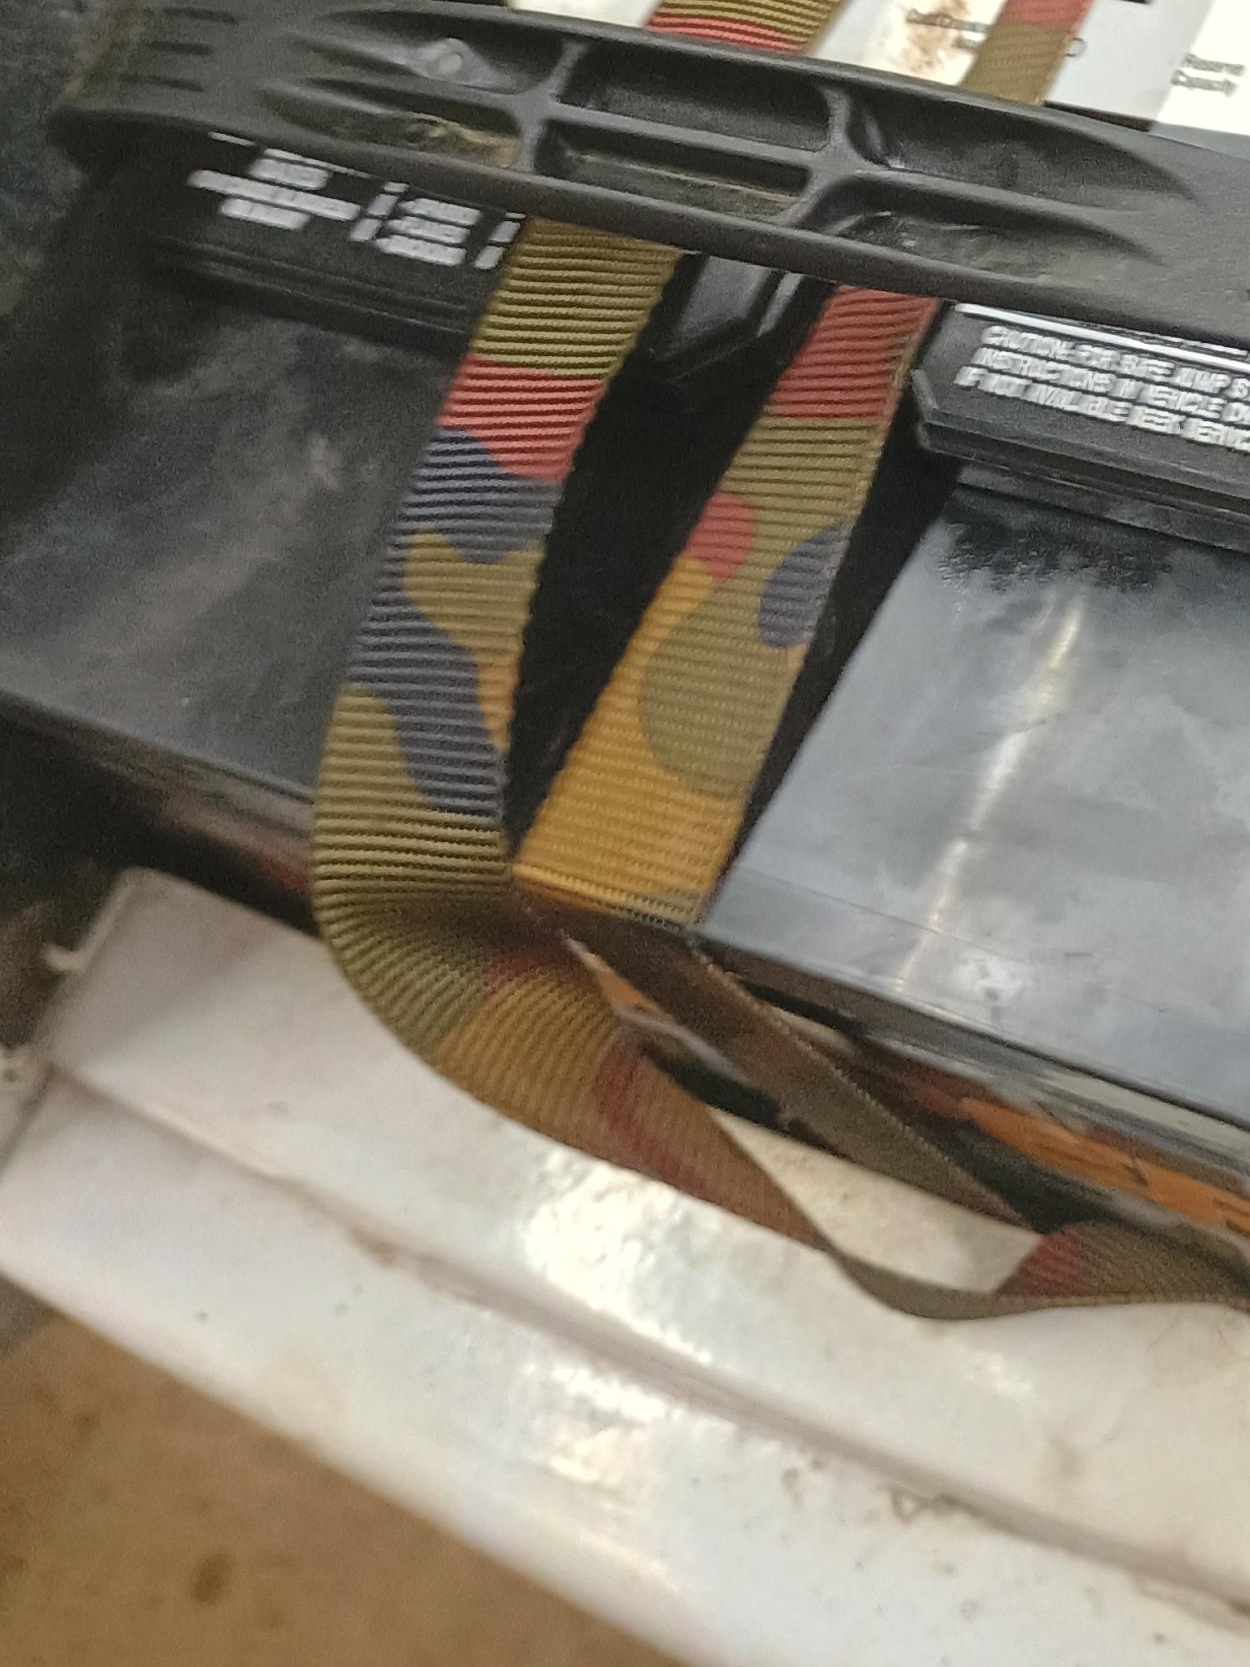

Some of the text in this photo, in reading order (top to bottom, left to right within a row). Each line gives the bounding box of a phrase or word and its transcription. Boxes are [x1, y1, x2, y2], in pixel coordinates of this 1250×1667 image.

[970, 347, 1115, 394] INSTRUCTIONS
[1138, 383, 1227, 420] VEHICLE
[977, 372, 1033, 399] NOT
[1022, 383, 1133, 424] AVAILABLE
[1126, 405, 1188, 435] SEEK
[1119, 353, 1175, 382] SAFE
[1174, 365, 1232, 395] JUMP
